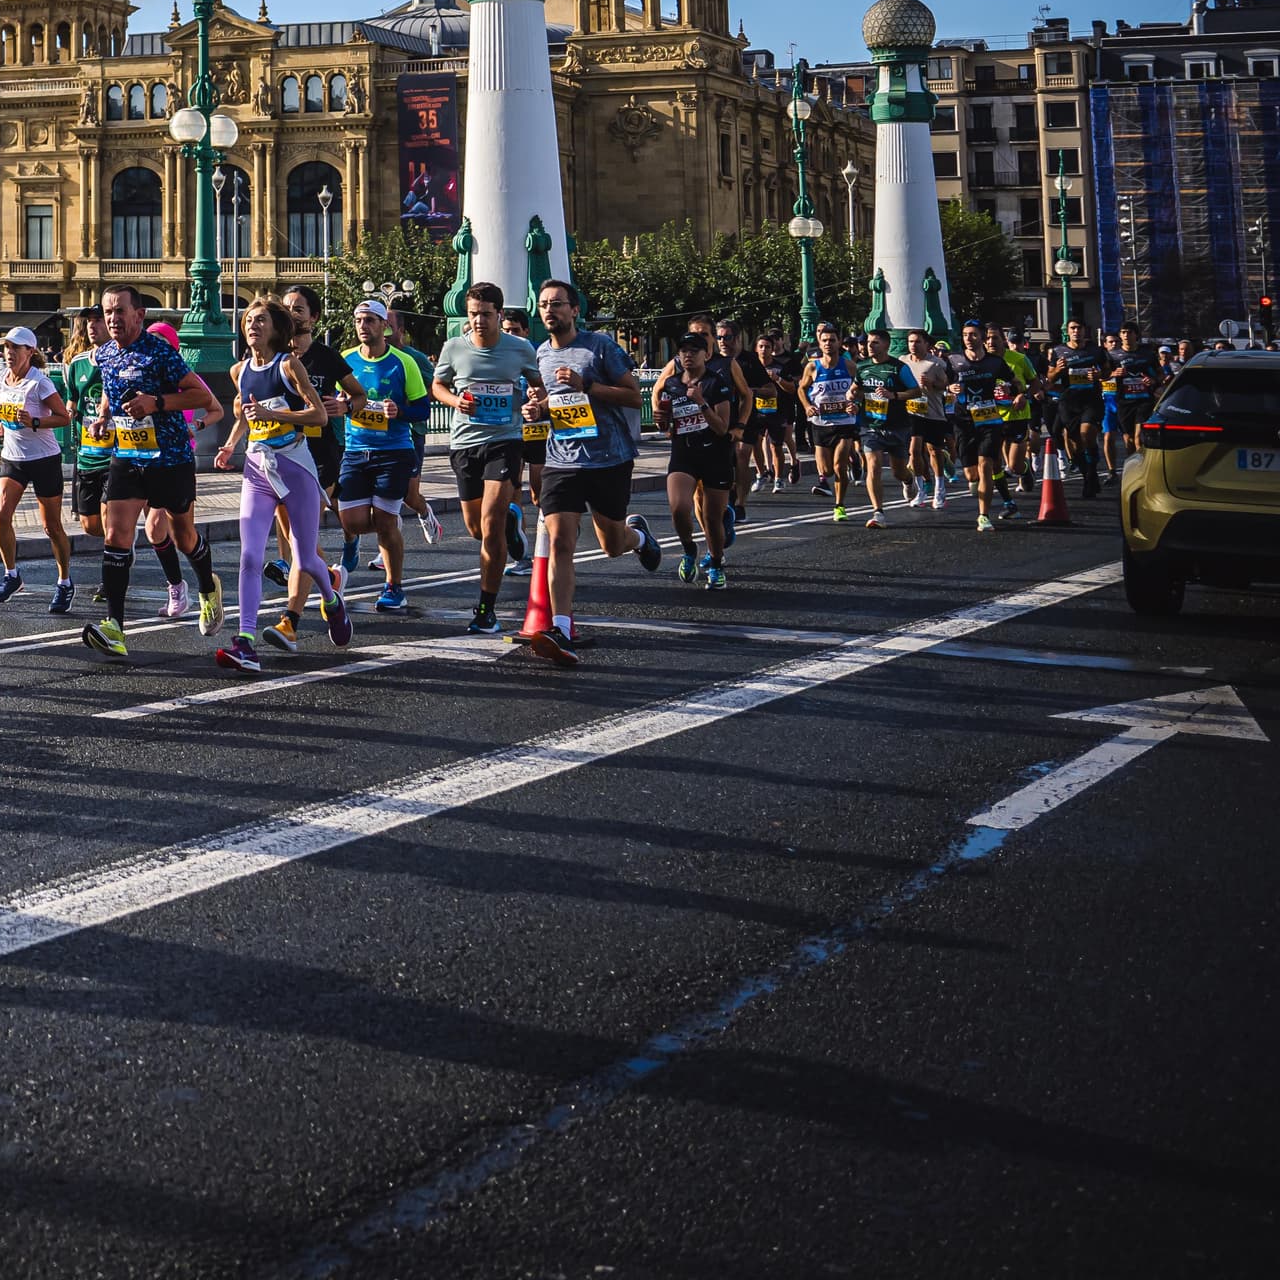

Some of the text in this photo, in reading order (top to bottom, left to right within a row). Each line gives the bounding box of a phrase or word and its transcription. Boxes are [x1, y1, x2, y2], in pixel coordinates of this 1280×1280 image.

[418, 110, 438, 129] 35
[818, 380, 849, 392] SALTO
[354, 411, 384, 424] 2449
[556, 407, 589, 421] 2528
[120, 430, 149, 442] 2189
[1250, 452, 1275, 469] 87
